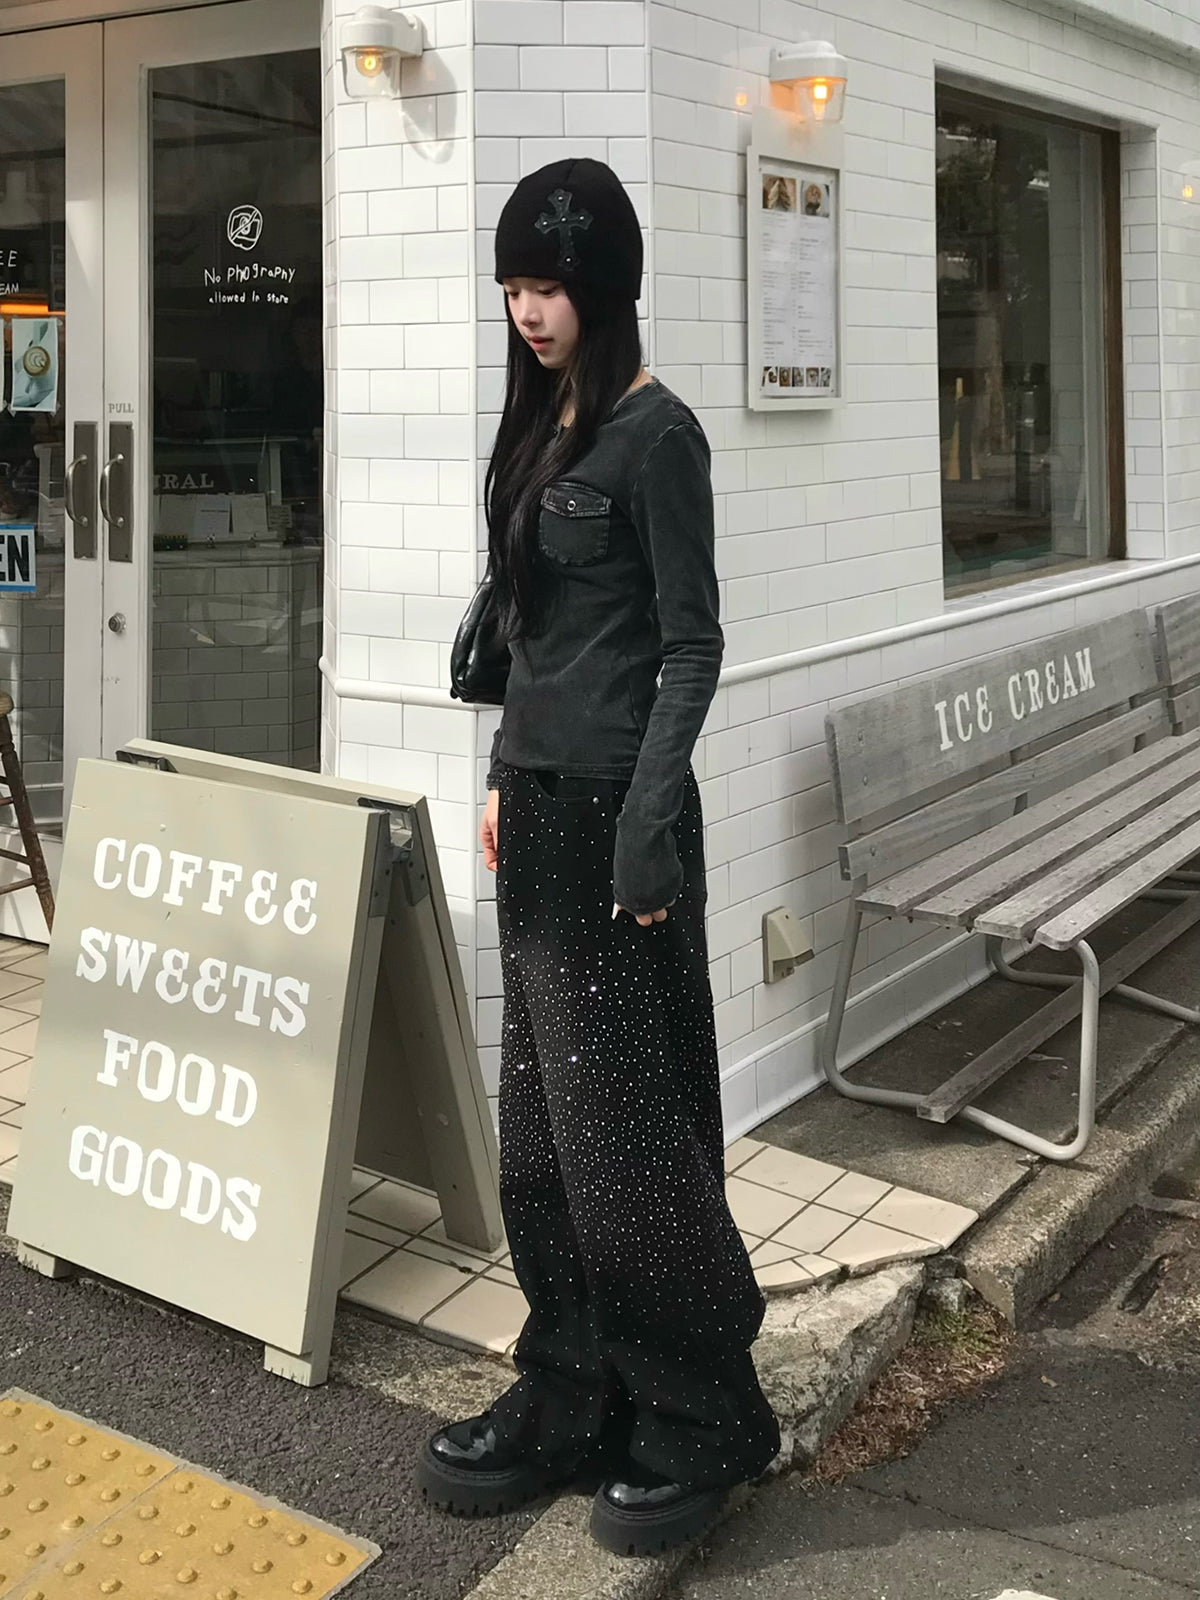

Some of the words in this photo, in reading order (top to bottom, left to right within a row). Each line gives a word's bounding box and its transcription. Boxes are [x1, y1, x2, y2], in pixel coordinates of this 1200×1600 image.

[204, 267, 221, 287] No
[208, 291, 246, 304] allowed
[266, 293, 289, 304] store
[108, 403, 134, 414] PULL
[934, 685, 993, 751] ICE
[1007, 647, 1096, 721] CREAM
[93, 837, 318, 935] COFFEE
[76, 926, 310, 1037] SWEETS
[97, 1029, 258, 1128] FOOD
[69, 1125, 262, 1242] GOODS
